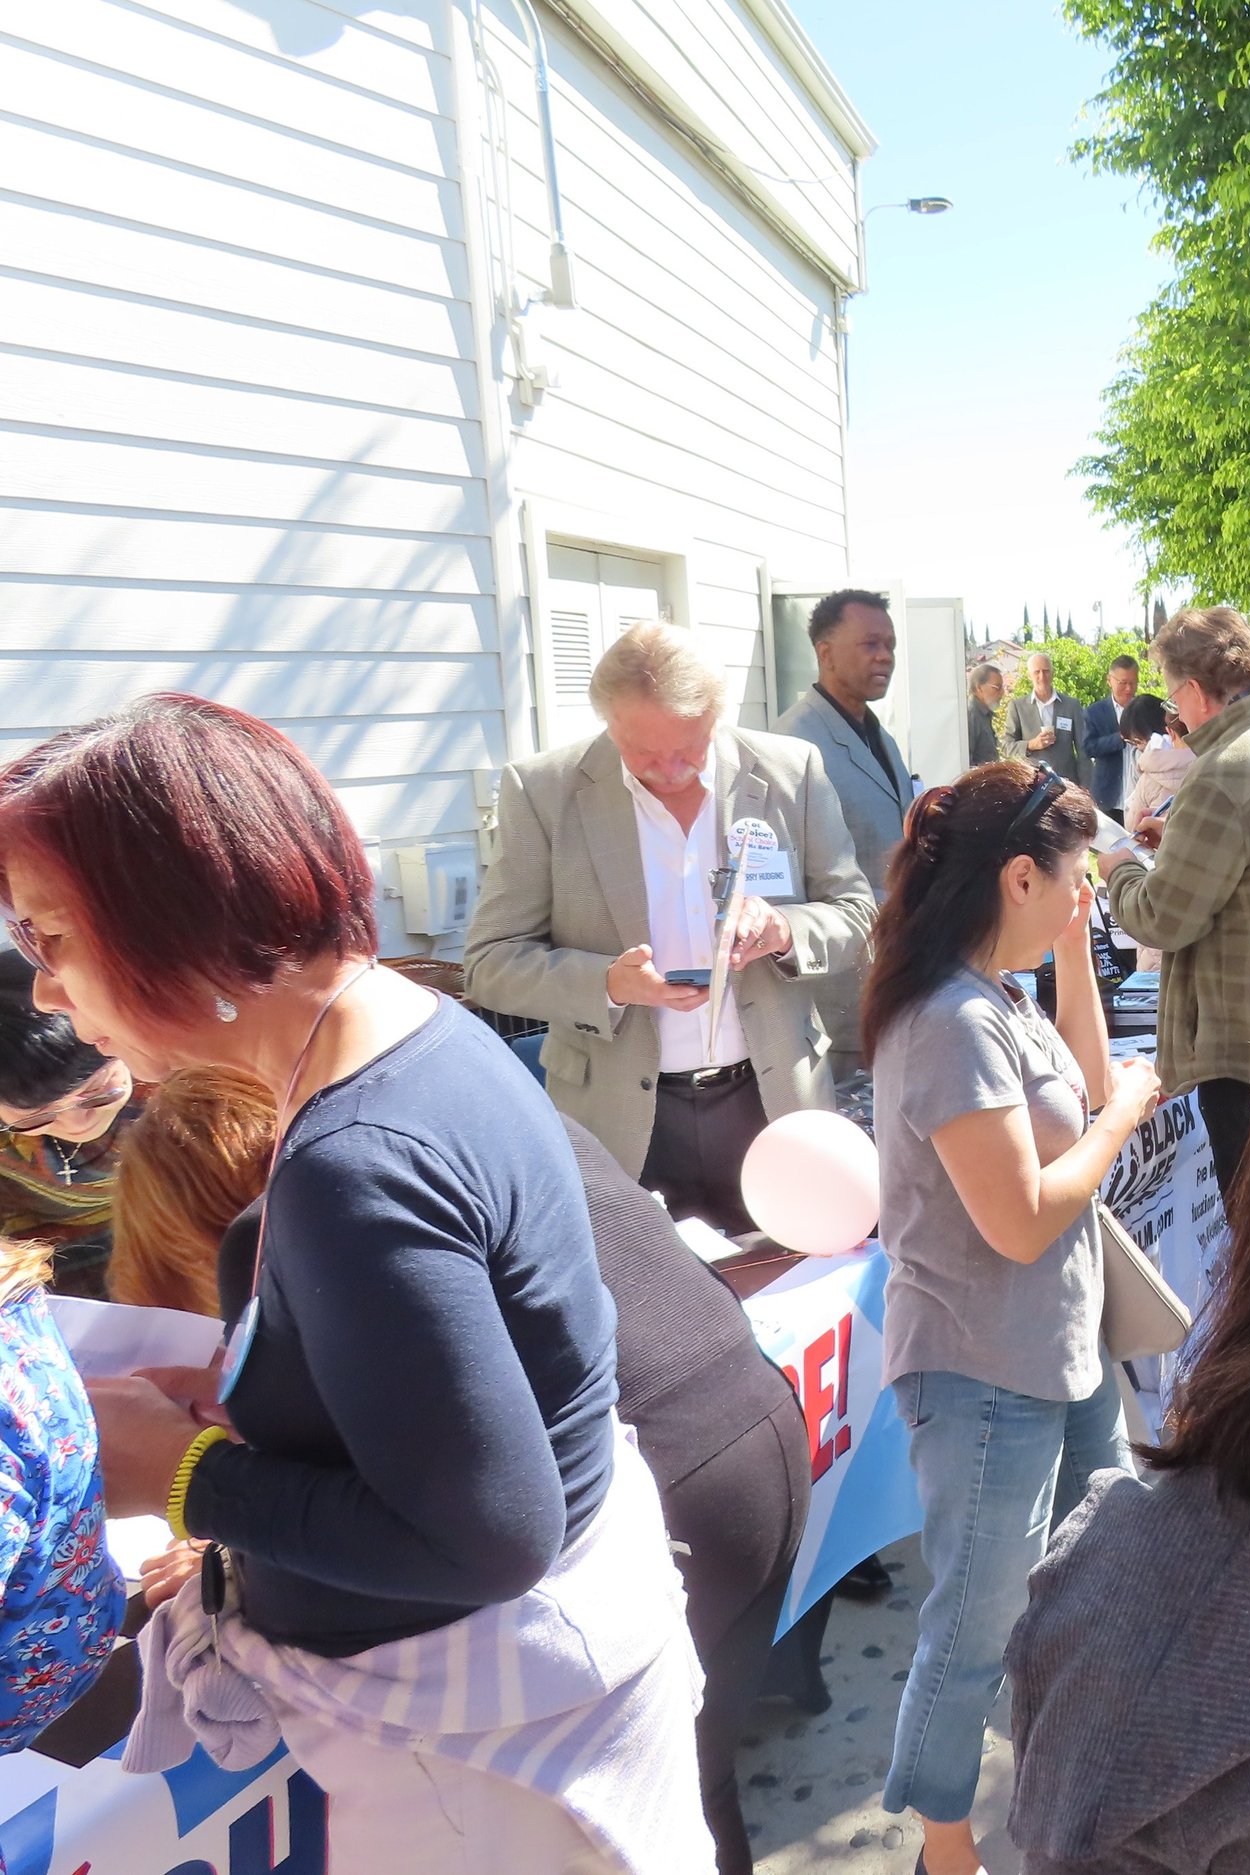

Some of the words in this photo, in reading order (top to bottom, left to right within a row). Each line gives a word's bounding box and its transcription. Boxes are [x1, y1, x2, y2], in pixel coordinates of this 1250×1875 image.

[745, 872, 758, 882] RRY
[759, 871, 785, 880] HUDGINS
[1139, 1095, 1196, 1164] BLACK
